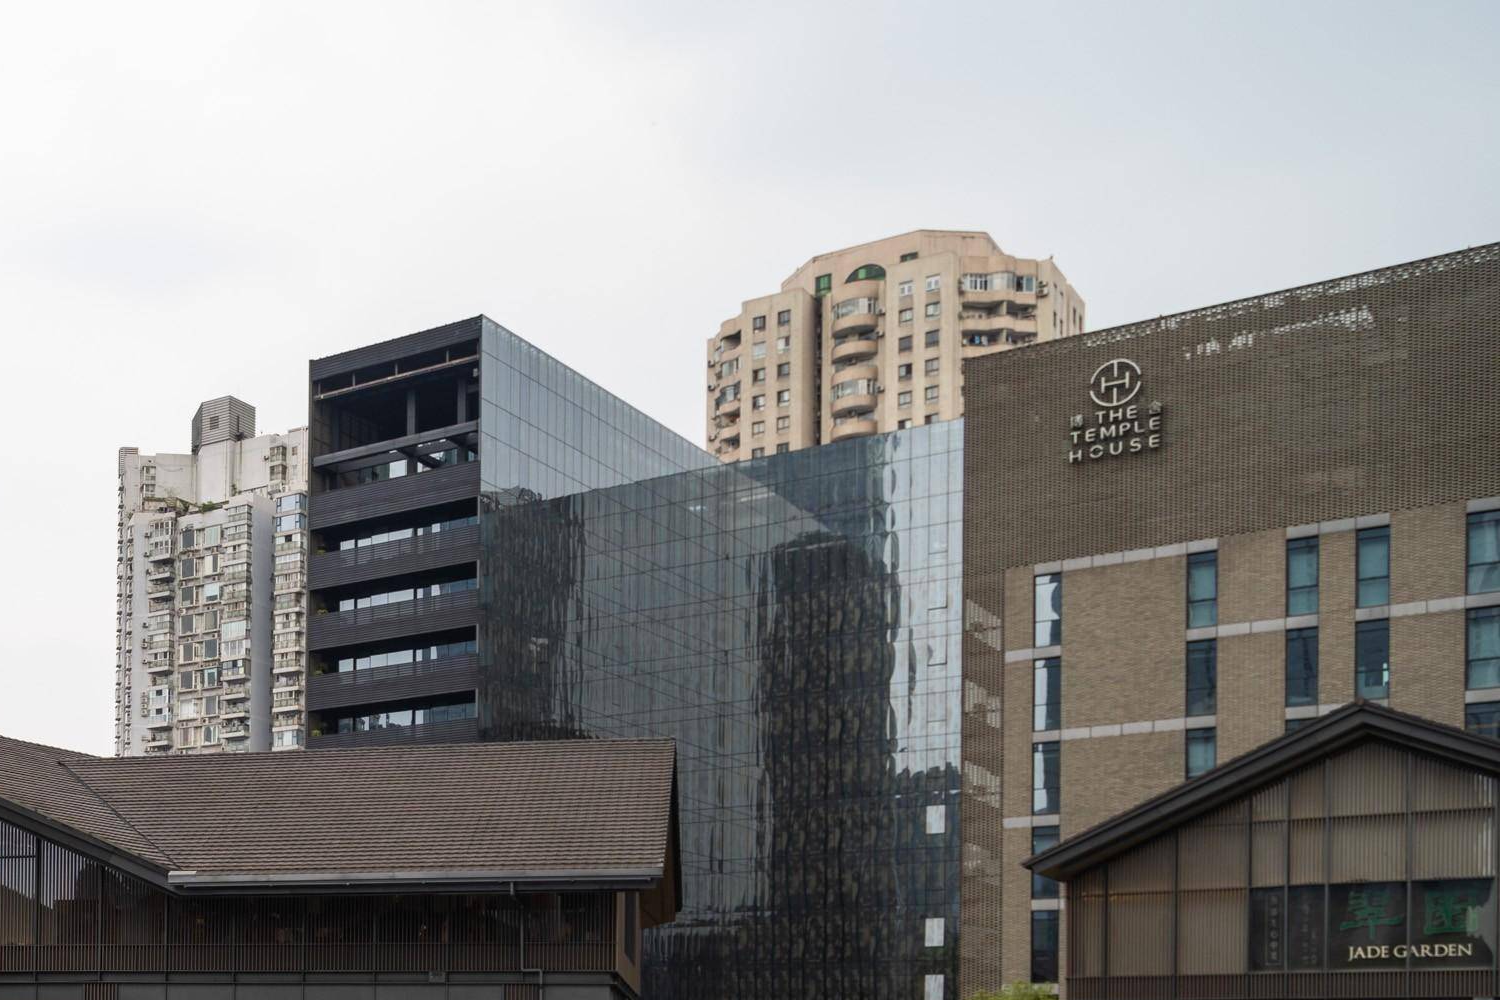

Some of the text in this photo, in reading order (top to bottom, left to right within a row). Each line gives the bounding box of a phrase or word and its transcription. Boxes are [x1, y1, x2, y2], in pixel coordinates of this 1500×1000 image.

[1095, 405, 1138, 424] THE
[1070, 416, 1161, 444] TEMPLE
[1068, 434, 1161, 463] HOUSE
[1348, 943, 1473, 962] JADE GARDEN
